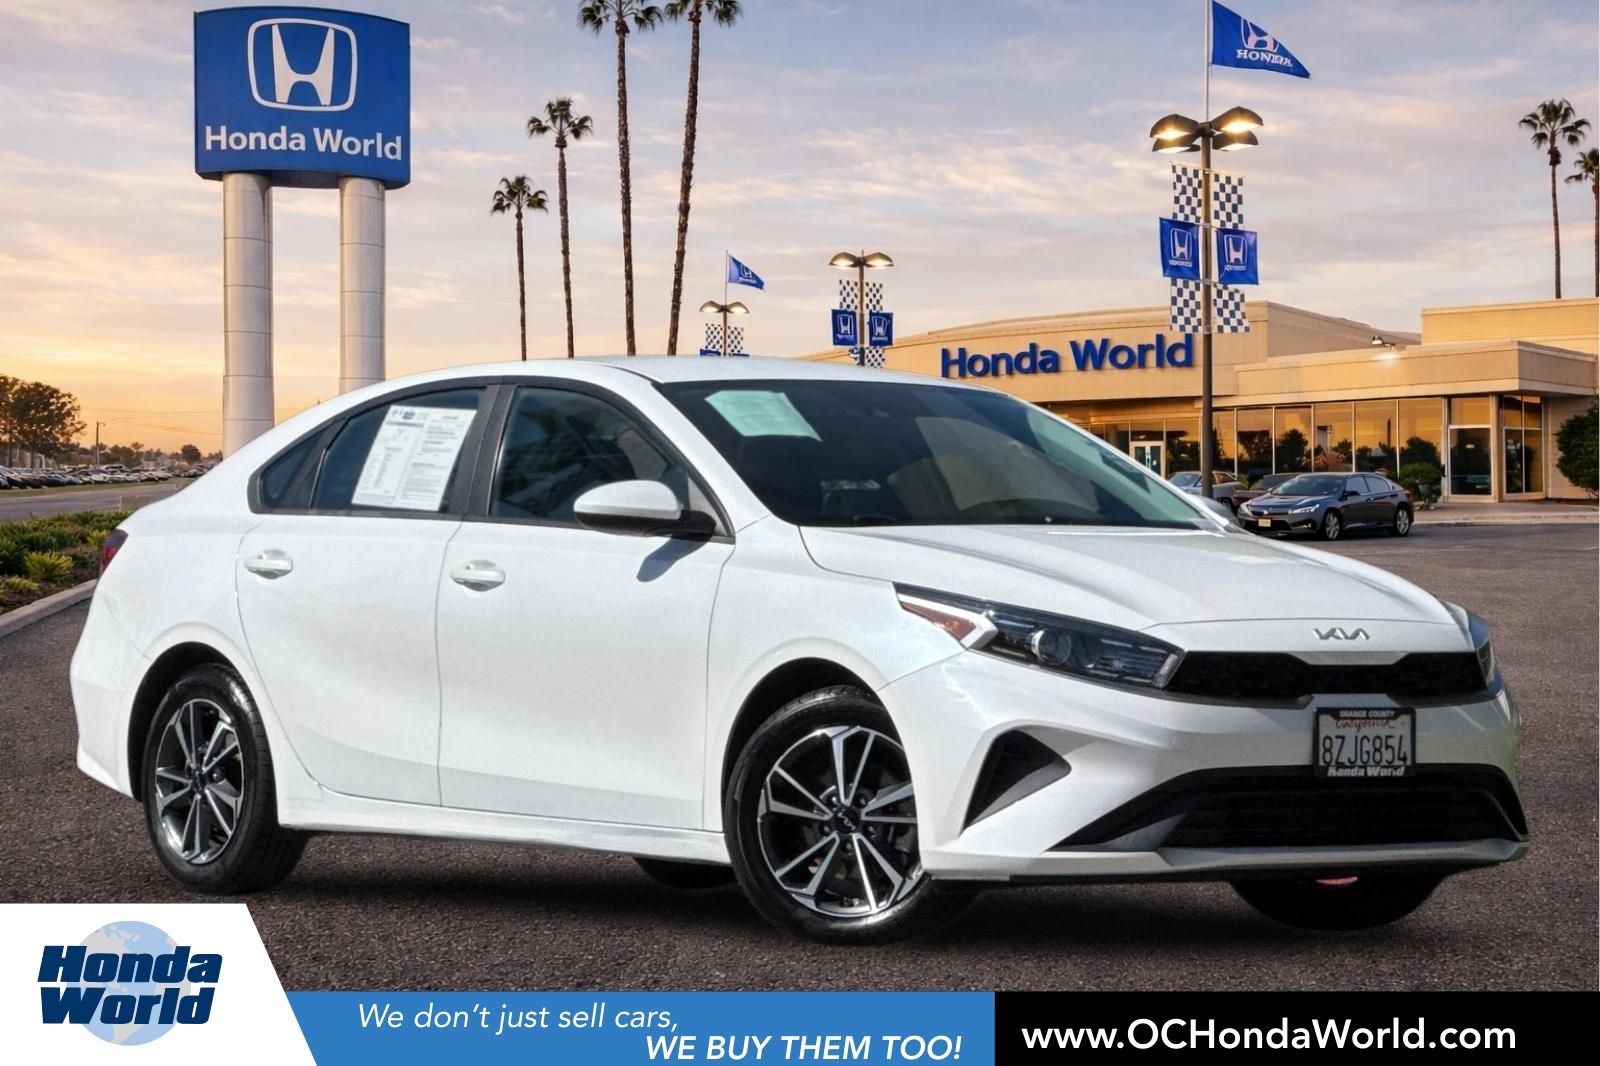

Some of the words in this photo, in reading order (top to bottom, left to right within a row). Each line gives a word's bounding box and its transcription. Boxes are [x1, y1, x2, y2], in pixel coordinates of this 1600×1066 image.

[205, 125, 306, 151] Honda
[313, 127, 402, 160] World
[940, 342, 1061, 378] Honda
[1069, 333, 1194, 370] World
[1322, 735, 1407, 764] 8ZJG854
